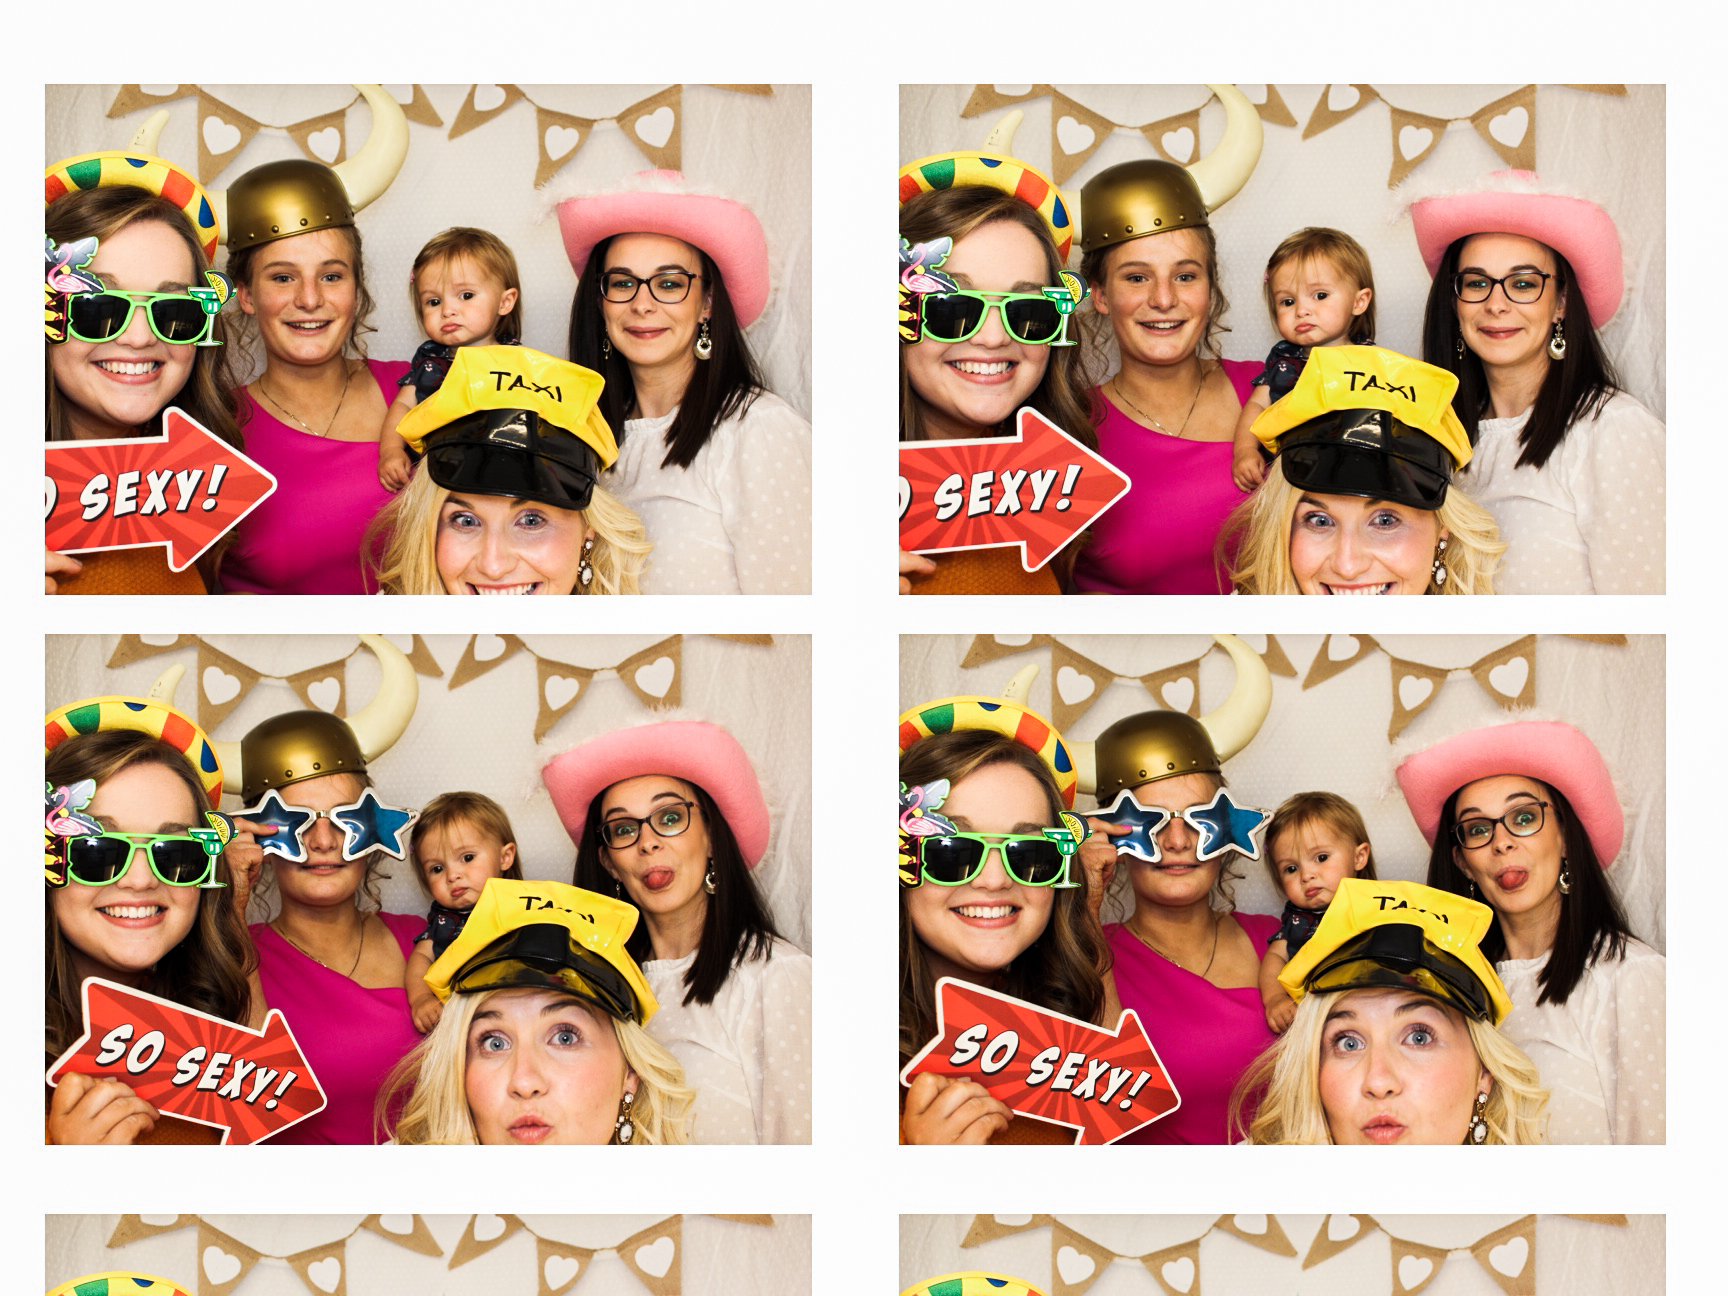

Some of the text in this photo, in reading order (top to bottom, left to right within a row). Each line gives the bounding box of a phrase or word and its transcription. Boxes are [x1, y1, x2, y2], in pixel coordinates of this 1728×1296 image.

[490, 371, 562, 402] TAXI
[1344, 371, 1416, 402] TAXI
[80, 464, 229, 522] SEXY!
[934, 464, 1083, 522] SEXY!
[95, 1023, 298, 1111] SO SEXY!
[949, 1023, 1152, 1111] SO SEXY!
